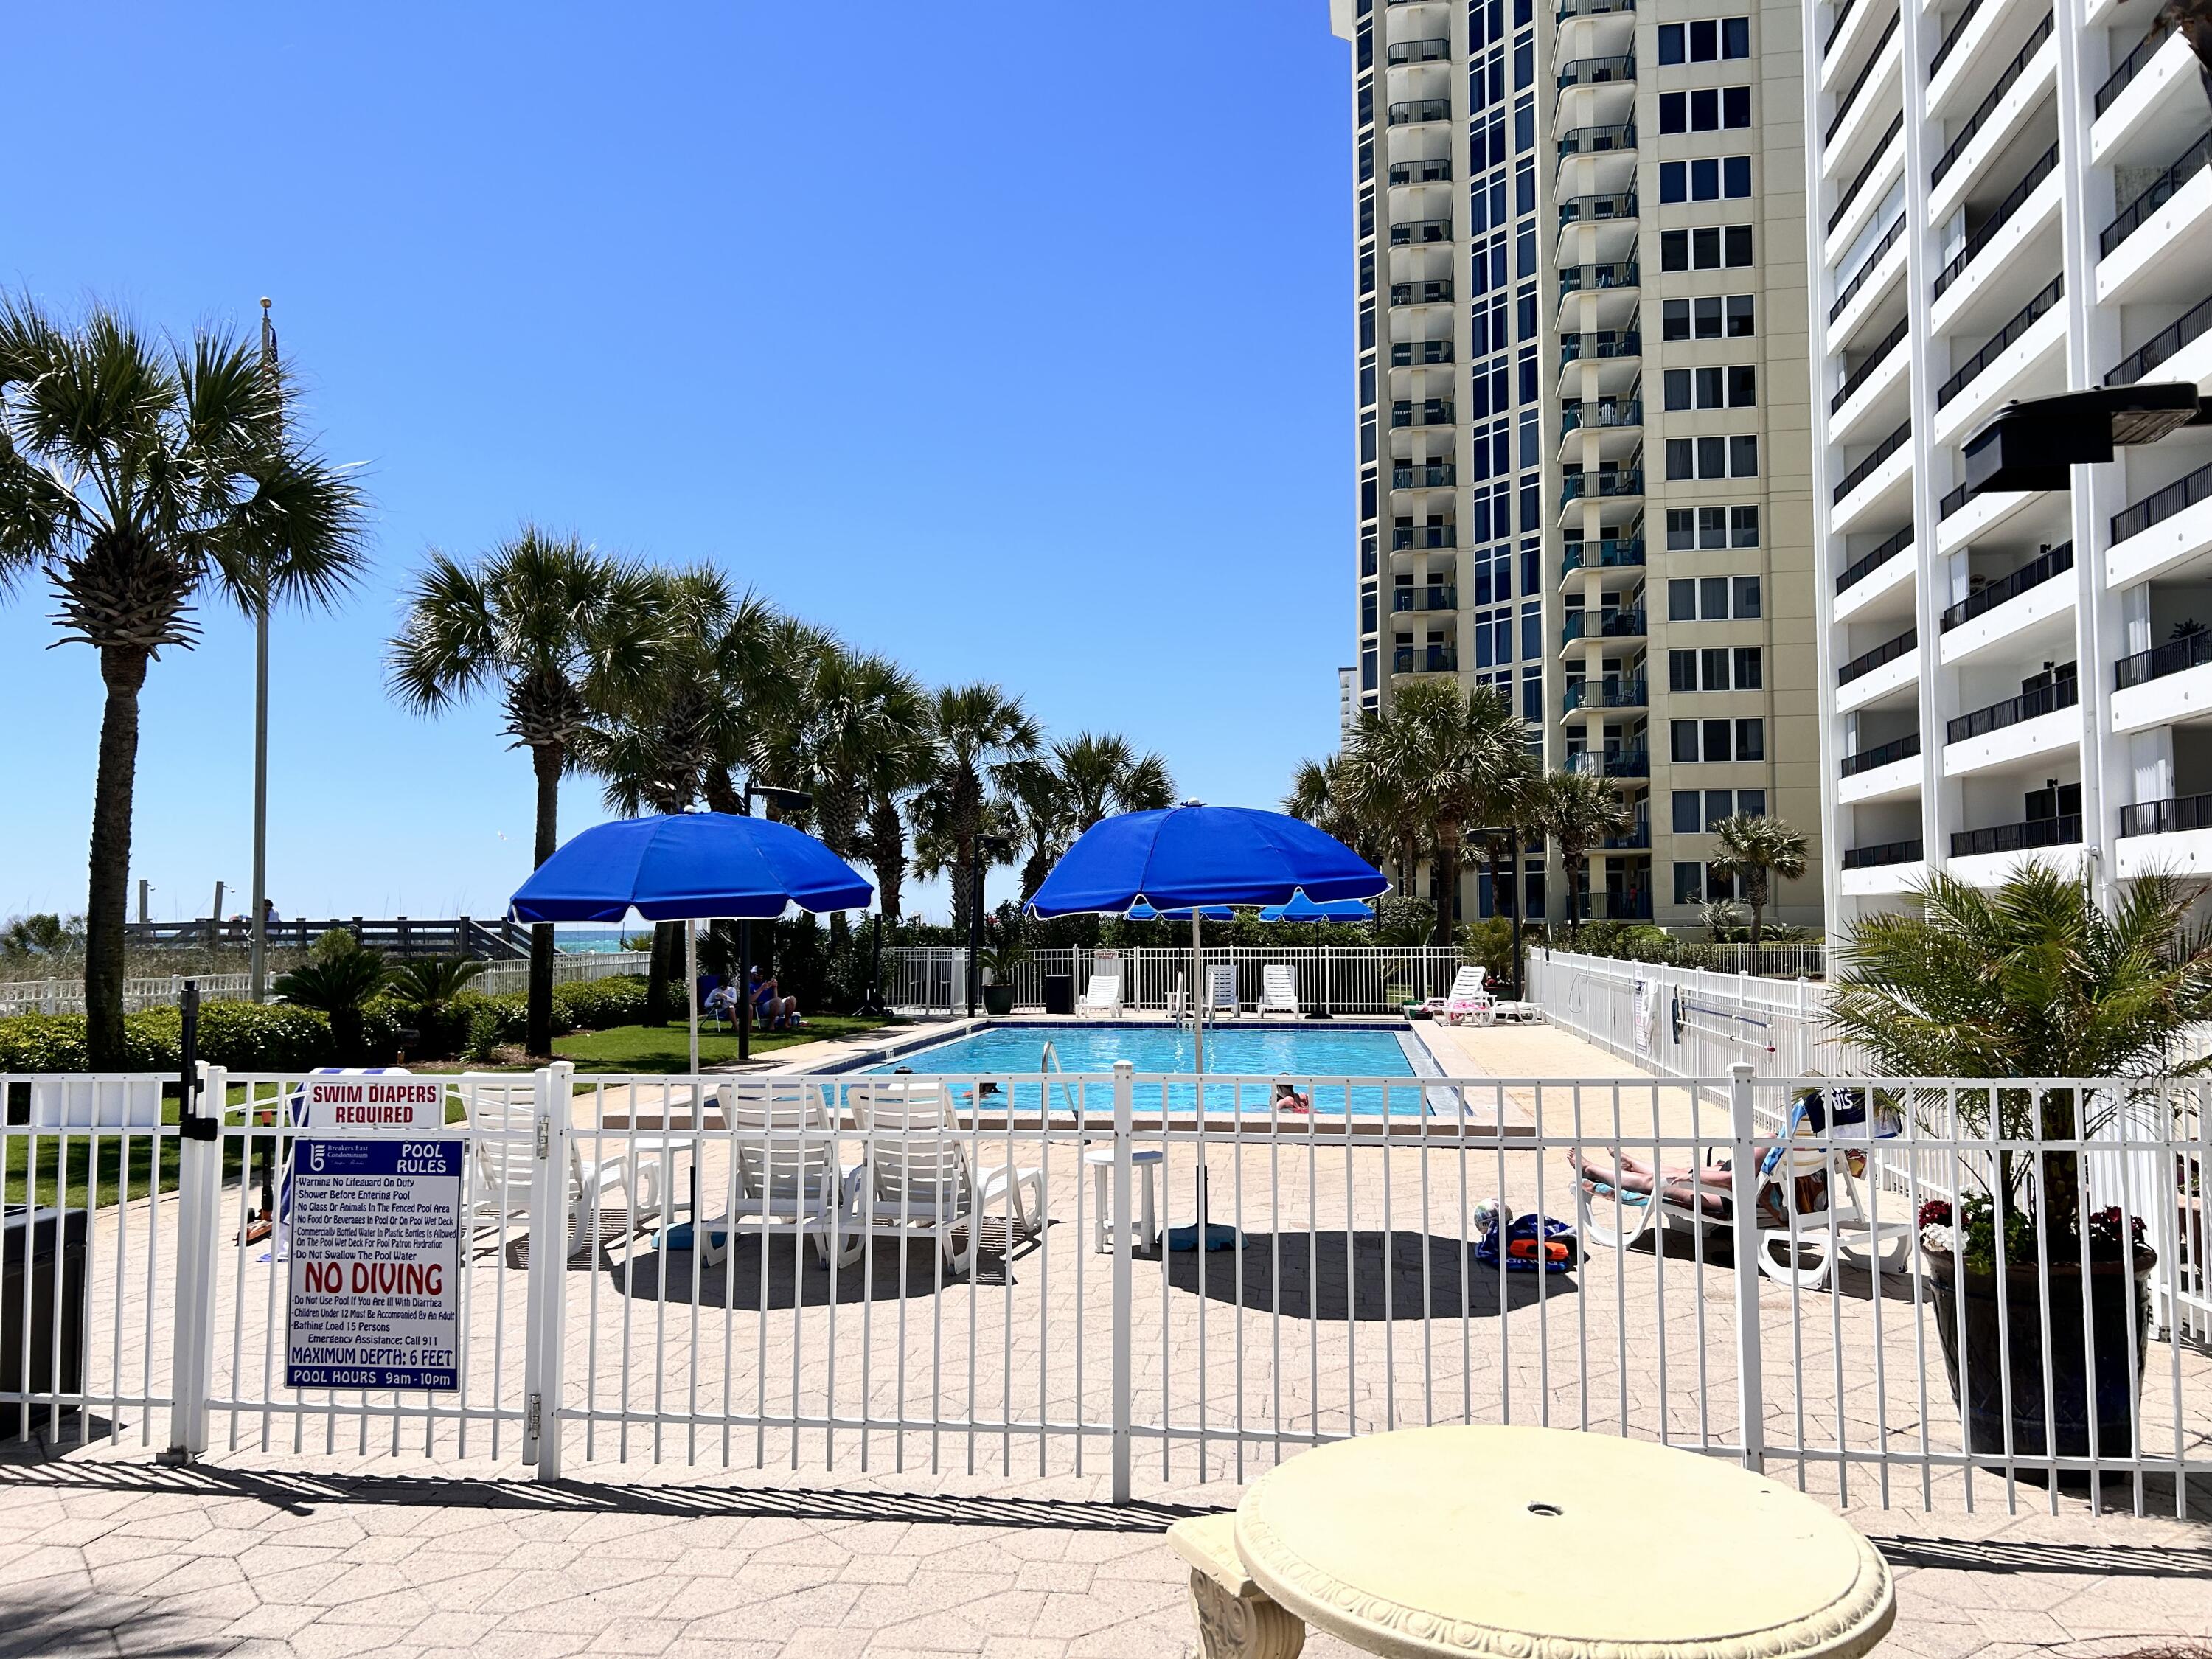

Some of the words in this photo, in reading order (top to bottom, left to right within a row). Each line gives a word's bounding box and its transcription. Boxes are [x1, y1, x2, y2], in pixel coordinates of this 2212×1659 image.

[313, 1085, 362, 1103] SWIM
[369, 1085, 437, 1103] DIAPERS
[335, 1106, 414, 1123] REQUIRED
[402, 1144, 443, 1158] POOL
[397, 1159, 447, 1173] RULES
[333, 1178, 344, 1186] No
[346, 1178, 381, 1187] Lifeguard
[383, 1178, 394, 1187] On
[397, 1178, 414, 1187] Duty
[330, 1190, 355, 1199] Before
[358, 1190, 391, 1200] Entering
[393, 1191, 410, 1200] Pool
[309, 1203, 327, 1211] Glass
[329, 1203, 338, 1211] Or
[340, 1203, 366, 1212] Animals
[369, 1203, 375, 1212] In
[378, 1203, 389, 1212] The
[392, 1203, 415, 1213] Fenced
[417, 1204, 432, 1213] Pool
[434, 1204, 450, 1213] Area
[307, 1214, 322, 1224] Food
[324, 1215, 333, 1224] Or
[333, 1215, 366, 1225] Beverages
[367, 1216, 373, 1225] In
[375, 1216, 389, 1225] Pool
[390, 1216, 397, 1225] Or
[399, 1216, 408, 1225] On
[409, 1216, 423, 1225] Pool
[425, 1217, 437, 1225] Wet
[438, 1217, 453, 1226] Deck
[336, 1228, 357, 1237] Bottled
[358, 1228, 375, 1237] Water
[378, 1228, 383, 1237] In
[384, 1228, 403, 1237] Plastic
[405, 1228, 425, 1238] Bottles
[427, 1229, 432, 1238] Is
[434, 1229, 456, 1239] Allowed
[296, 1237, 305, 1246] On
[307, 1237, 319, 1247] The
[320, 1238, 333, 1247] Pool
[335, 1238, 347, 1247] Wet
[348, 1238, 363, 1247] Deck
[365, 1239, 375, 1248] For
[377, 1239, 390, 1248] Pool
[392, 1239, 411, 1248] Patron
[414, 1239, 443, 1249] Hydration
[309, 1250, 323, 1259] Not
[324, 1250, 356, 1259] Swallow
[358, 1251, 372, 1259] The
[375, 1251, 392, 1260] Pool
[394, 1251, 417, 1261] Water
[305, 1262, 343, 1293] NO
[352, 1262, 442, 1295] DIVING
[305, 1295, 318, 1305] Not
[319, 1296, 333, 1305] Use
[334, 1296, 349, 1305] Pool
[351, 1296, 357, 1305] If
[358, 1296, 371, 1306] You
[372, 1297, 385, 1307] Are
[395, 1298, 411, 1307] With
[413, 1298, 442, 1307] Diarrhea
[321, 1309, 339, 1318] Under
[341, 1310, 349, 1318] 12
[350, 1310, 366, 1318] Must
[367, 1310, 375, 1318] Be
[377, 1310, 417, 1320] Accompanied
[419, 1310, 427, 1320] By
[428, 1311, 437, 1320] An
[438, 1311, 454, 1321] Adult
[325, 1321, 344, 1331] Load
[347, 1322, 355, 1331] 15
[358, 1322, 390, 1332] Persons
[308, 1334, 353, 1343] Emergency
[355, 1335, 403, 1345] Assistance:
[405, 1336, 420, 1345] Call
[422, 1336, 437, 1346] 911
[292, 1346, 355, 1364] MAXIMUM
[360, 1348, 406, 1366] DEPTH:
[410, 1349, 417, 1366] 6
[421, 1349, 453, 1366] FEET
[293, 1370, 327, 1382] POOL
[332, 1371, 377, 1384] HOURS
[386, 1372, 411, 1385] 9am
[420, 1373, 450, 1385] 10pm
